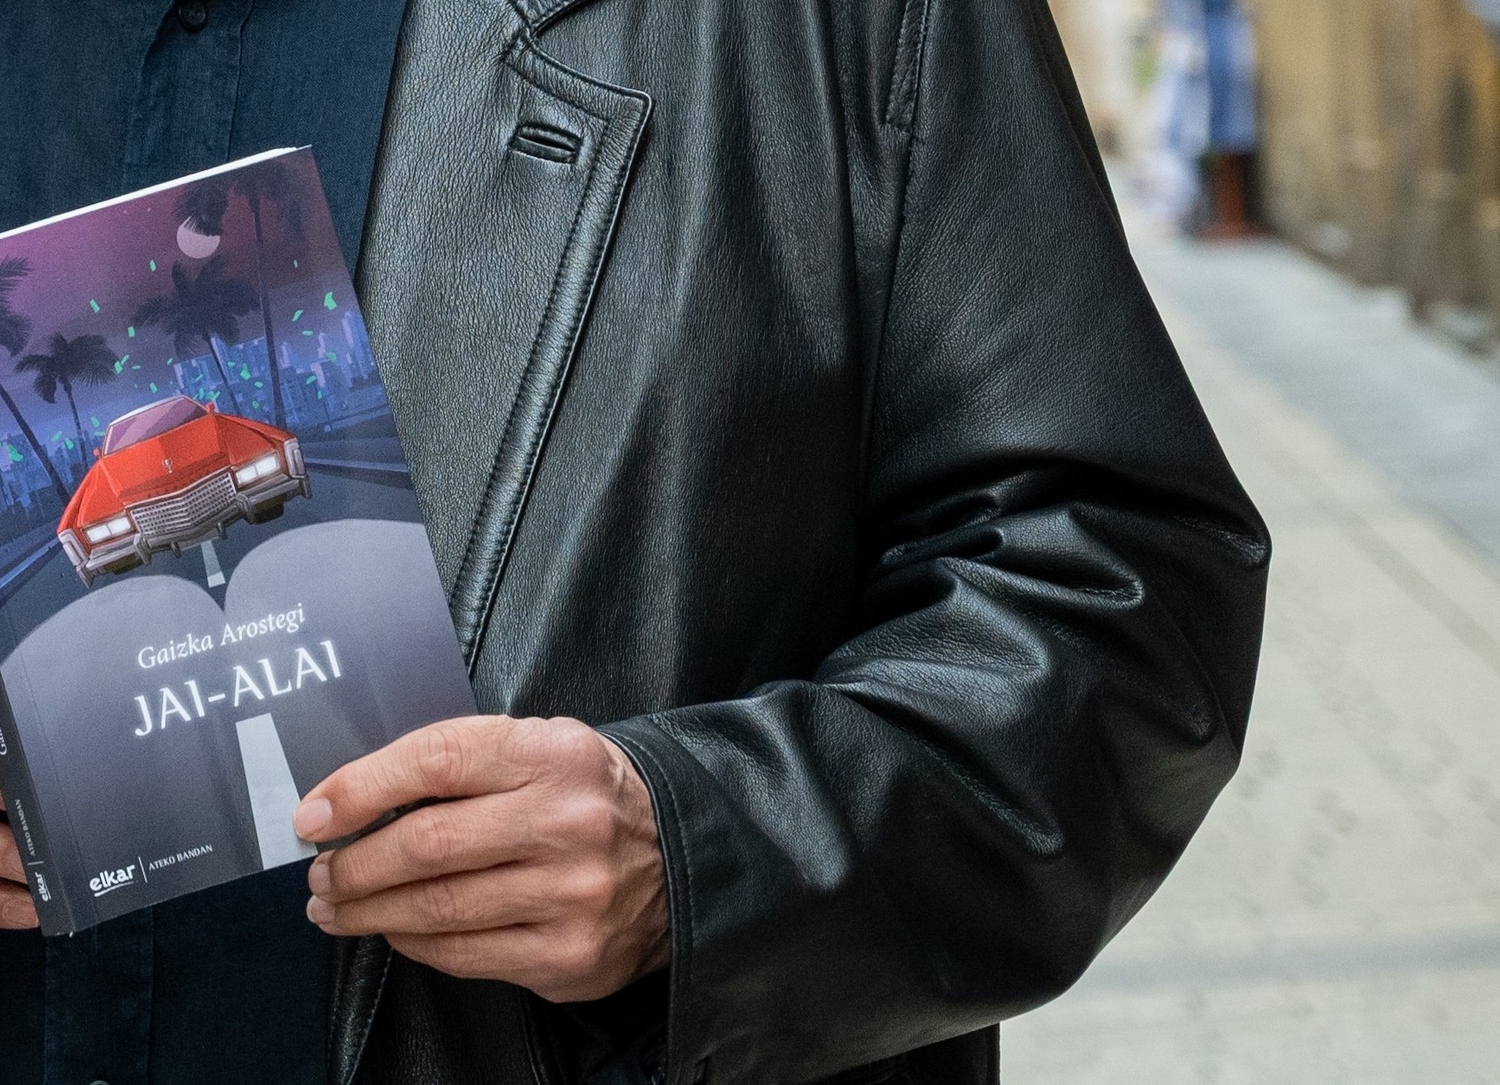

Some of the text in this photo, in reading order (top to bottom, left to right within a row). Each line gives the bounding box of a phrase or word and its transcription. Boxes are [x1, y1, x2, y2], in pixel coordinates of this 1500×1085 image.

[137, 602, 306, 670] Gaizka Arostegi
[133, 639, 342, 738] JAI-ALAI
[148, 844, 213, 872] ATEKO BANDAN
[34, 871, 50, 902] elkar
[89, 864, 136, 894] elkar
